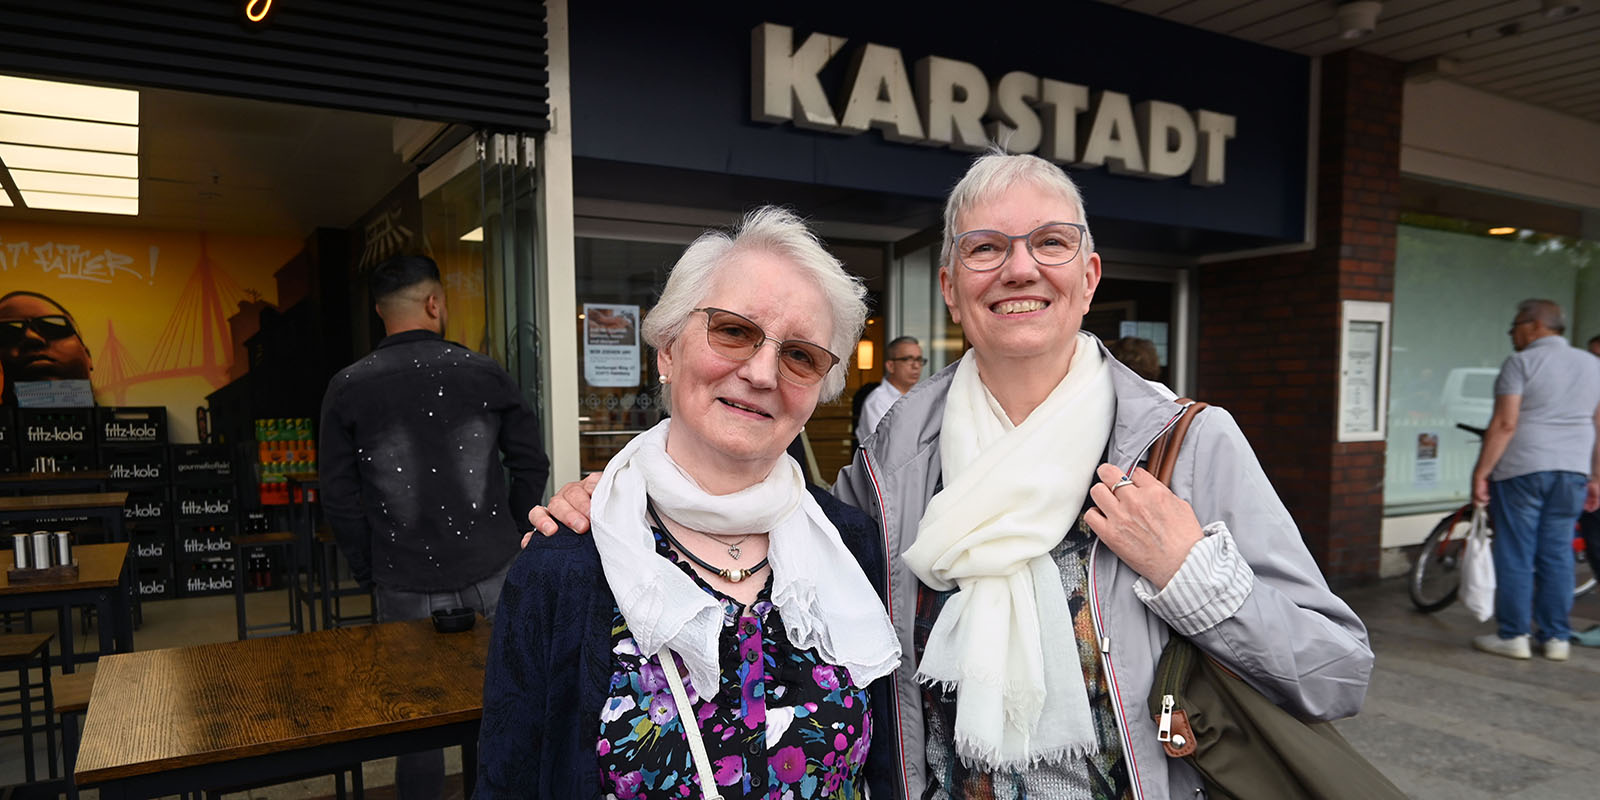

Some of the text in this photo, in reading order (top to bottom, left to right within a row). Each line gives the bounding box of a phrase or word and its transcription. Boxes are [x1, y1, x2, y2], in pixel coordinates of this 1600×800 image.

[752, 22, 1236, 186] KARSTADT
[28, 426, 83, 441] fritz-kola
[105, 423, 156, 438] fritz-kola
[110, 464, 160, 479] fritz-kola
[181, 500, 229, 515] fritz-kola
[184, 537, 231, 553] fritz-kola
[187, 576, 233, 591] fritz-kola
